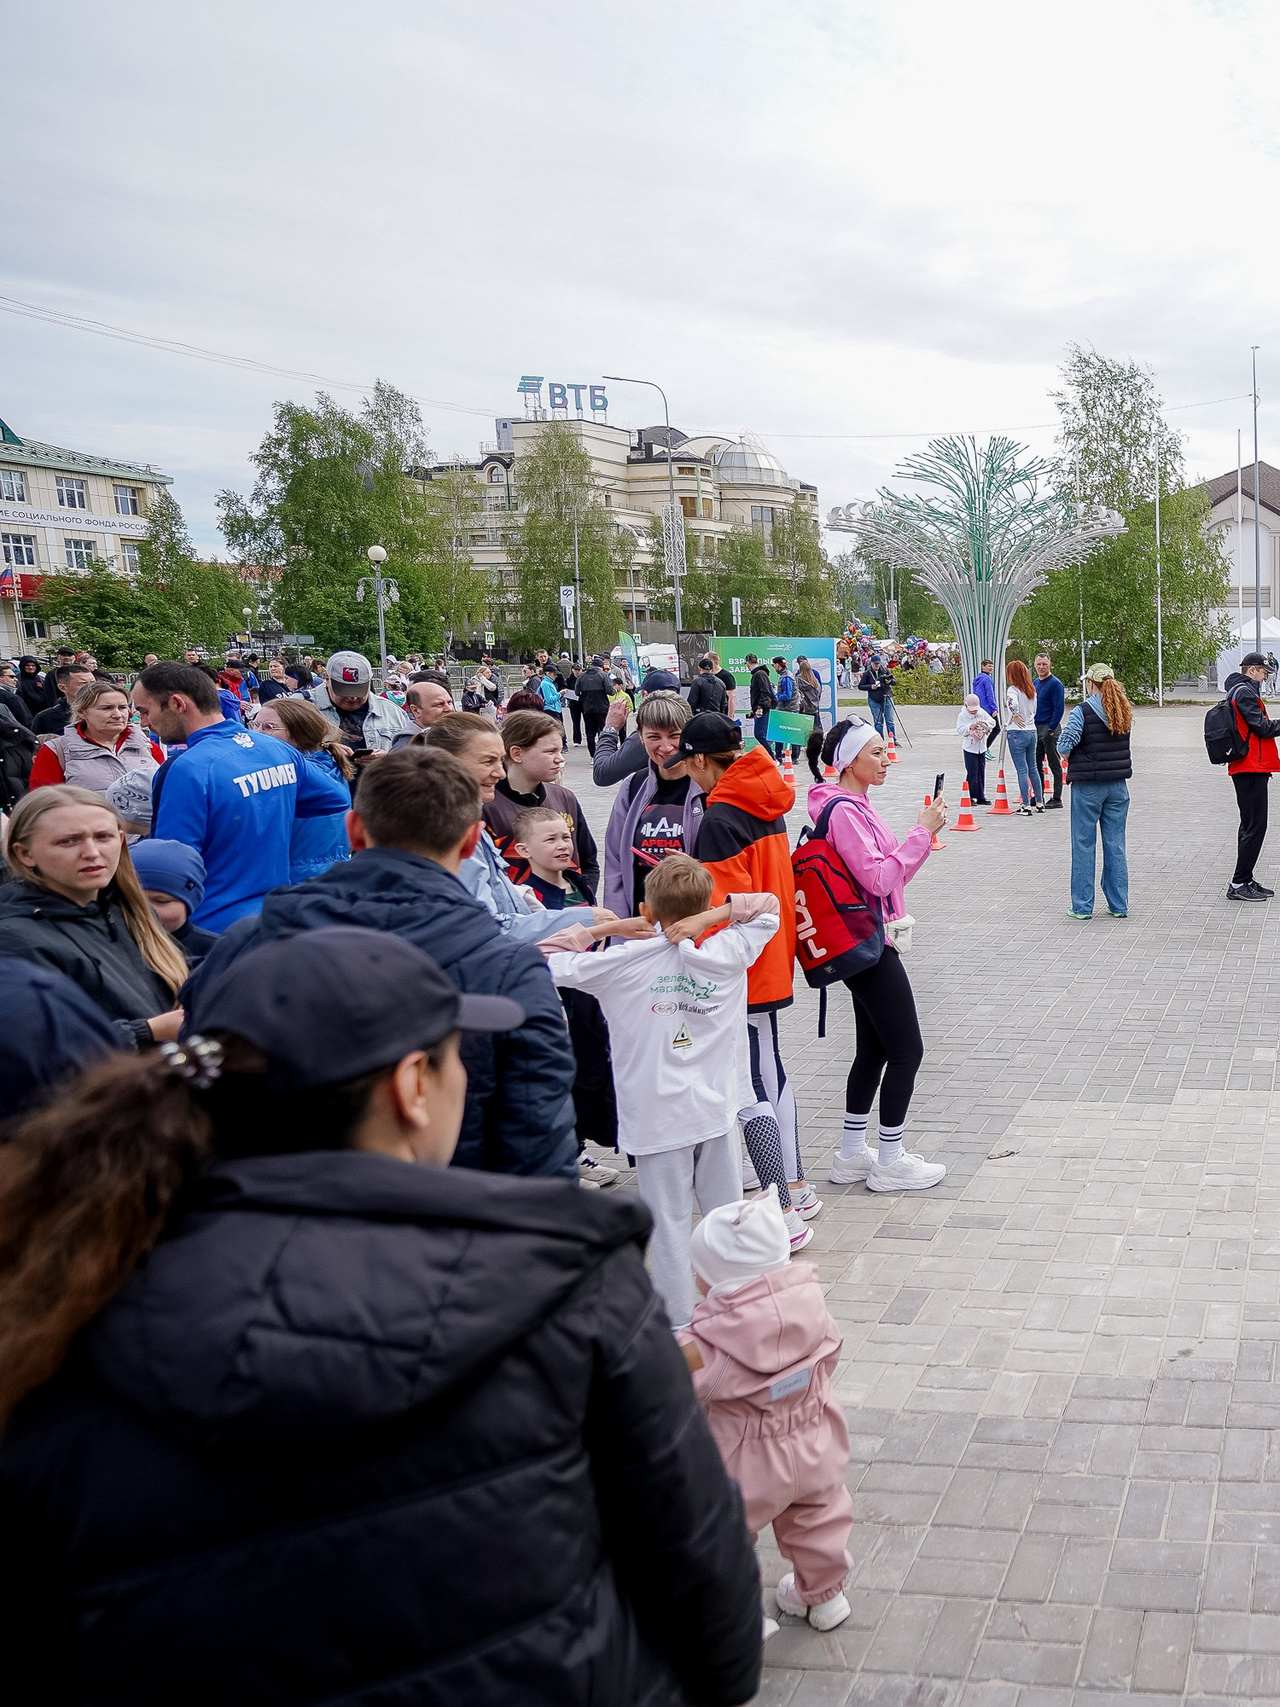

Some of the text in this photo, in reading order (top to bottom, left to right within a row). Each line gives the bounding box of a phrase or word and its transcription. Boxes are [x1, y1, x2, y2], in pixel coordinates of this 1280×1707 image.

[548, 383, 609, 411] ВТБ
[12, 510, 82, 524] СОЦИАЛЬНОГО
[84, 518, 117, 529] ФОНДА
[118, 521, 150, 531] РОССИ
[641, 839, 683, 848] АРЕНА
